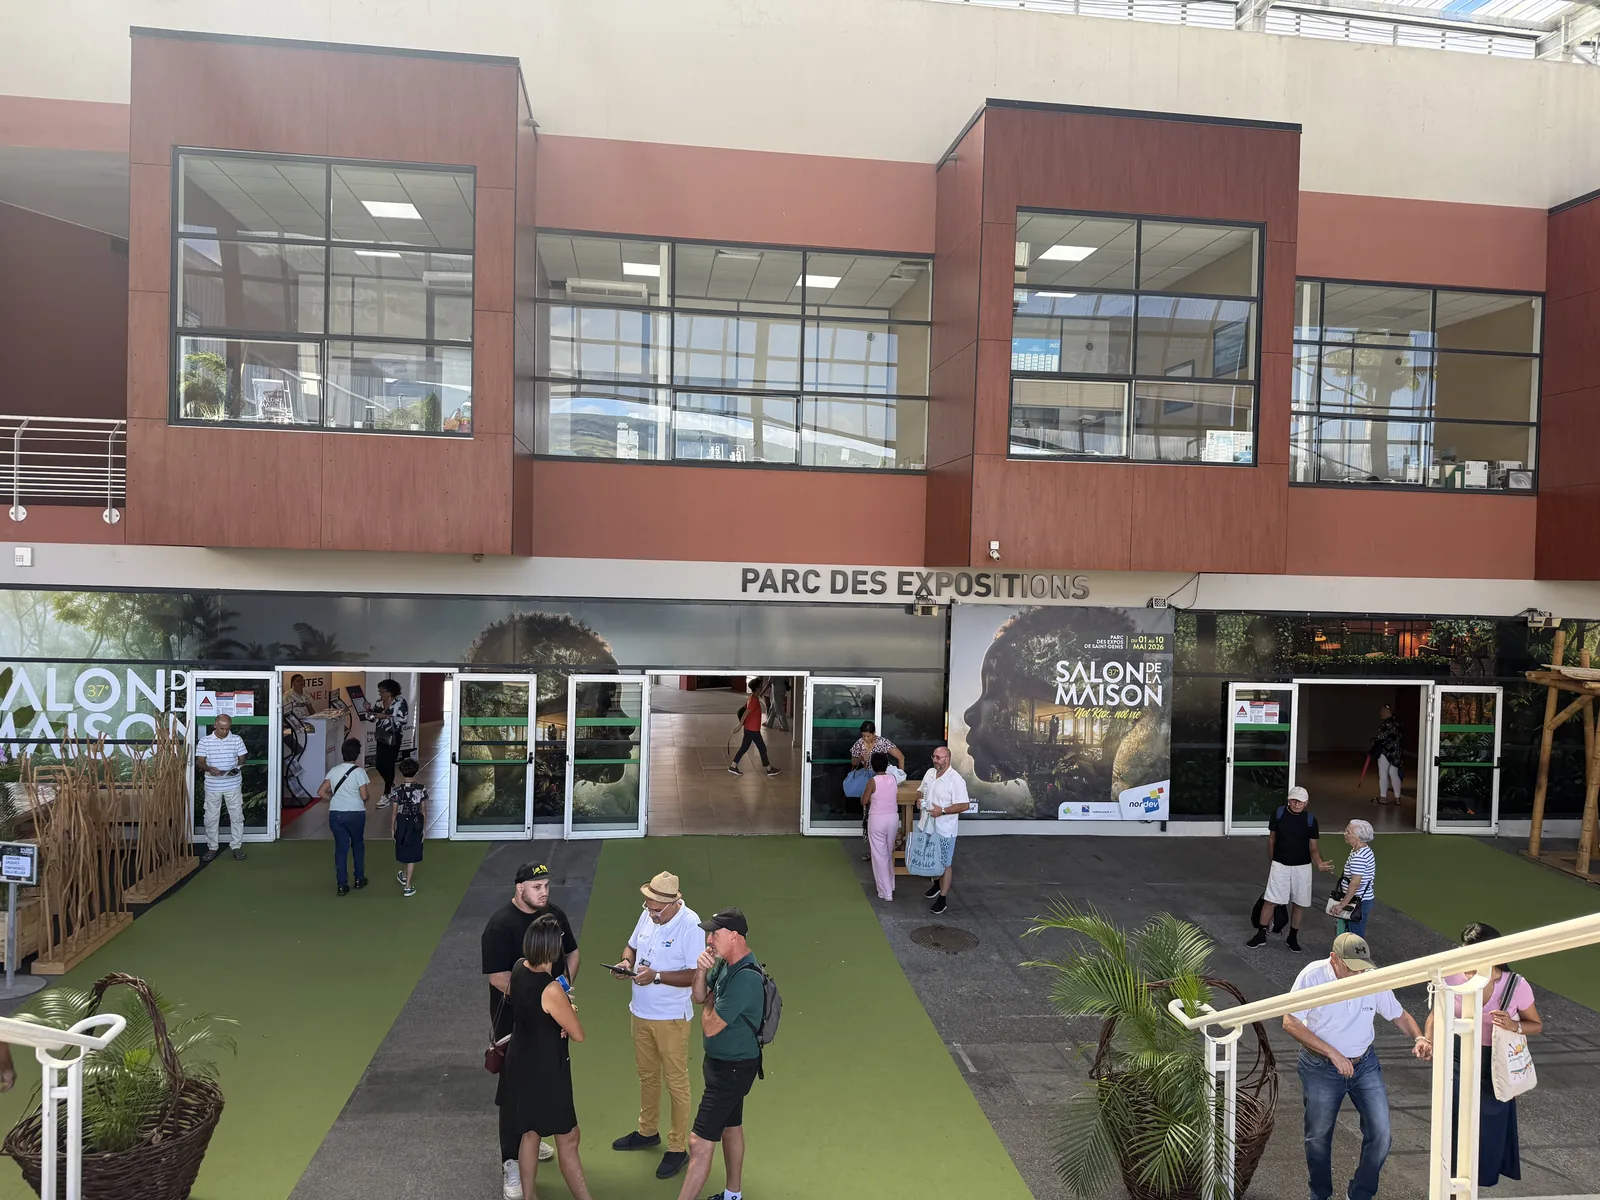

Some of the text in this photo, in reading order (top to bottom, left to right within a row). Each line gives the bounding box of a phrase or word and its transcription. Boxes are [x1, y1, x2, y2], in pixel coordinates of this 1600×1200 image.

[741, 568, 1090, 599] PARC DES EXPOSITIONS
[1155, 636, 1164, 644] 10
[1056, 660, 1162, 684] SALON DE
[303, 677, 324, 687] ITES
[1145, 673, 1162, 684] LA
[0, 667, 165, 712] ALON
[1055, 684, 1162, 707] MAISON
[1073, 707, 1091, 719] Not
[1114, 709, 1129, 719] not
[1129, 708, 1142, 719] vie
[1128, 800, 1159, 808] nordev
